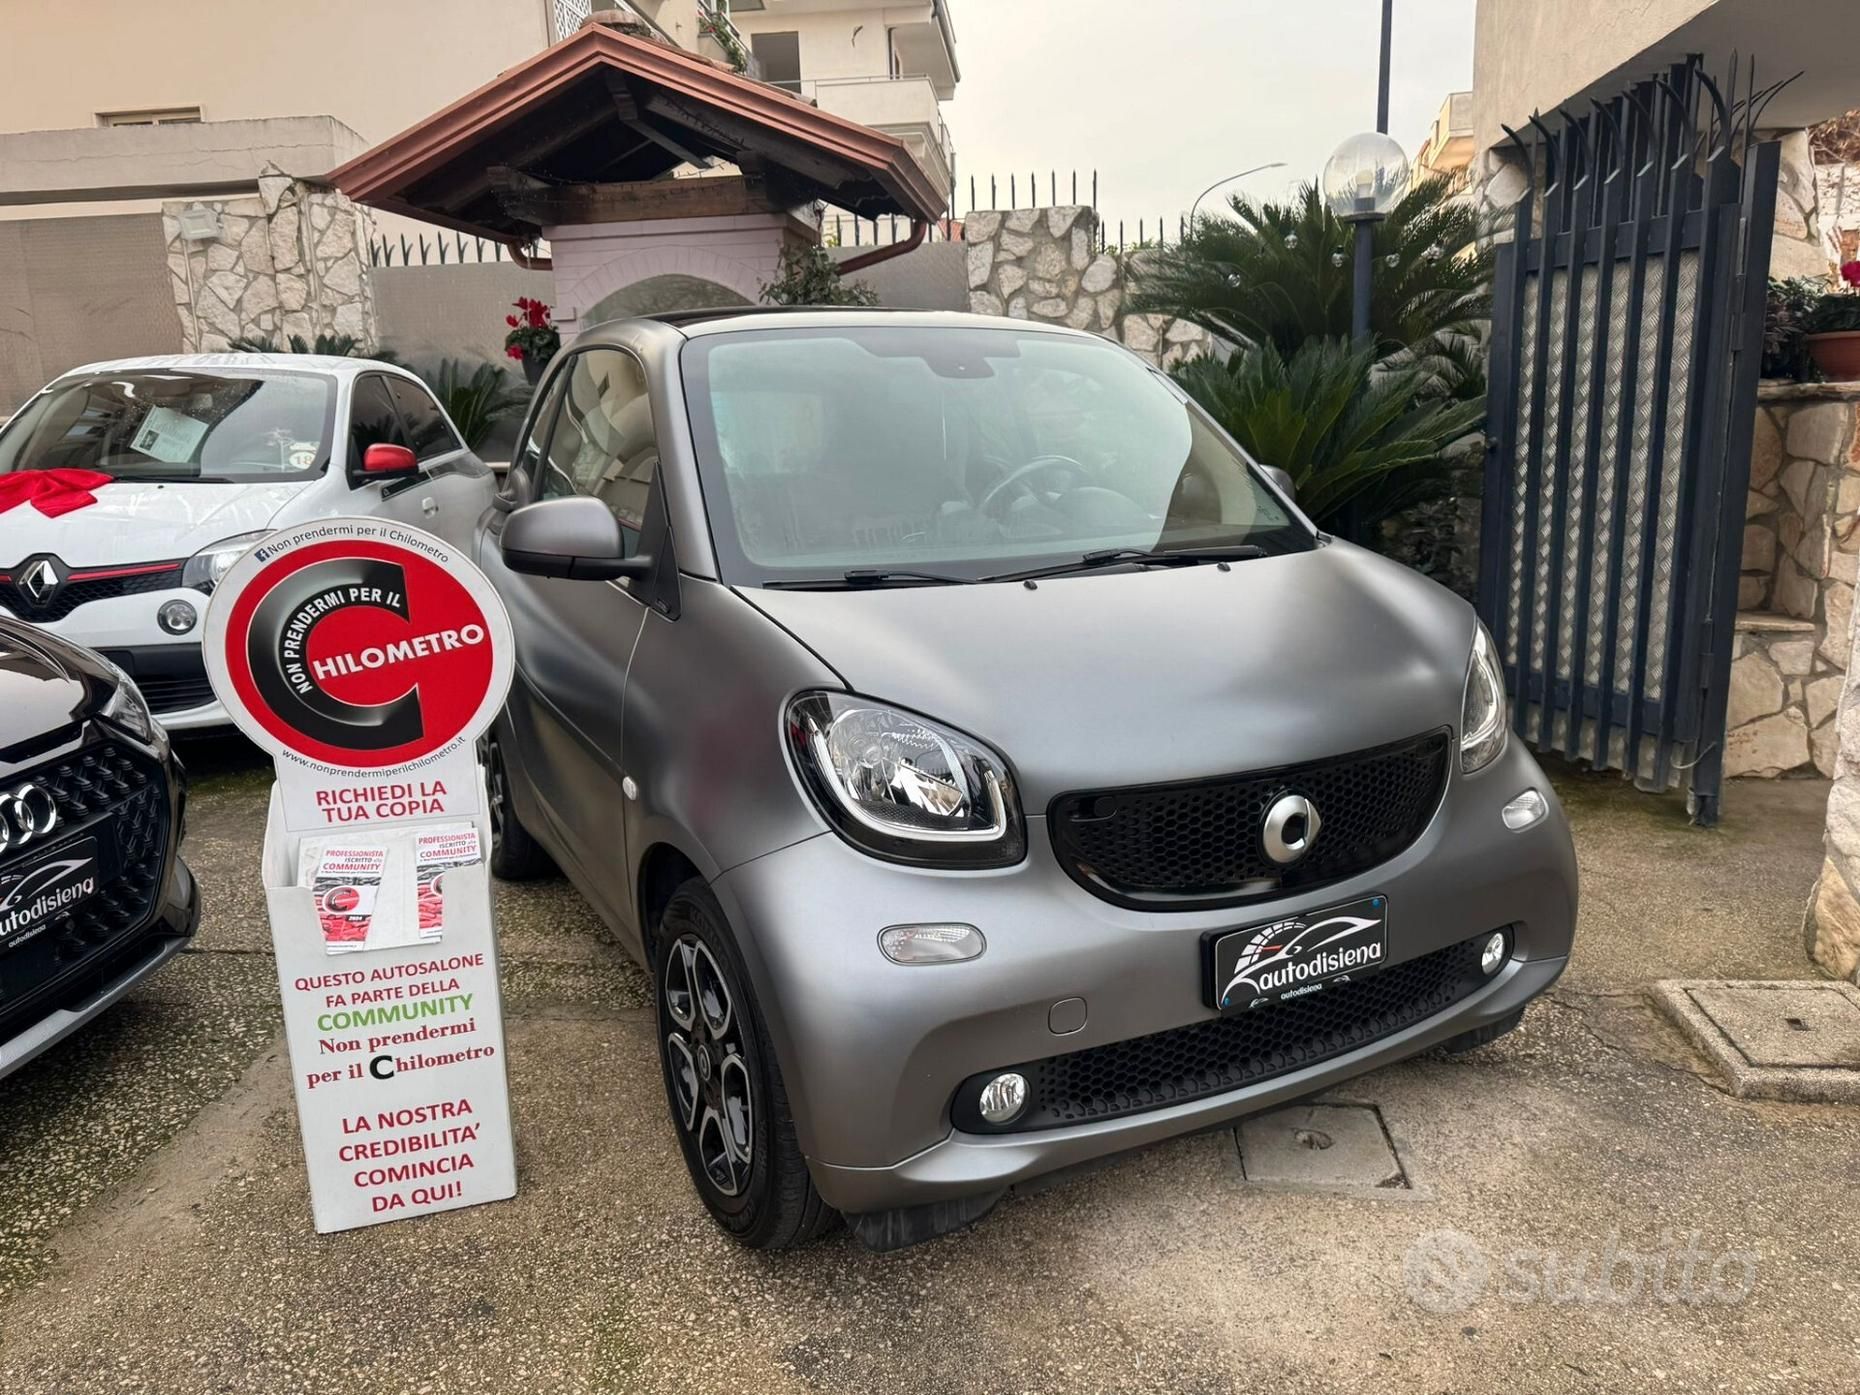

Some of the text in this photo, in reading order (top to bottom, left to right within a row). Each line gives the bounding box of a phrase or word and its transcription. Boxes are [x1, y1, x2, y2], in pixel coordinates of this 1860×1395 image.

[269, 540, 285, 556] Non
[293, 525, 354, 546] prendermi
[357, 526, 378, 538] per
[380, 527, 388, 537] il
[389, 529, 449, 564] Chilometro
[284, 587, 401, 694] NON PRENDERMI PER IL
[312, 623, 485, 680] HILOMETRO
[281, 736, 466, 778] www.nonprendermiperilchilometro.it
[316, 780, 447, 806] RICHIEDI LA
[321, 798, 445, 823] TUA COPIA
[325, 850, 384, 858] PROFESSIONISTA
[418, 833, 476, 845] PROFESSIONISTA
[420, 845, 478, 859] COMMUNITY
[439, 840, 466, 849] ISCRITTO
[322, 863, 381, 871] COMMUNITY
[0, 877, 95, 936] utodisiena
[8, 924, 47, 948] autodisiena
[294, 953, 484, 991] QUESTO AUTOSALONE
[1260, 942, 1381, 991] autodisiena
[325, 978, 460, 1008] FA PARTE DELLA
[1281, 983, 1322, 1000] autodisiena
[317, 993, 474, 1032] COMMUNITY
[319, 1017, 477, 1055] Non prendermi
[306, 1045, 495, 1089] per il Chilometro
[342, 1098, 473, 1134] LA NOSTRA
[354, 1153, 475, 1187] COMINCIA
[372, 1181, 463, 1213] DA QUI!
